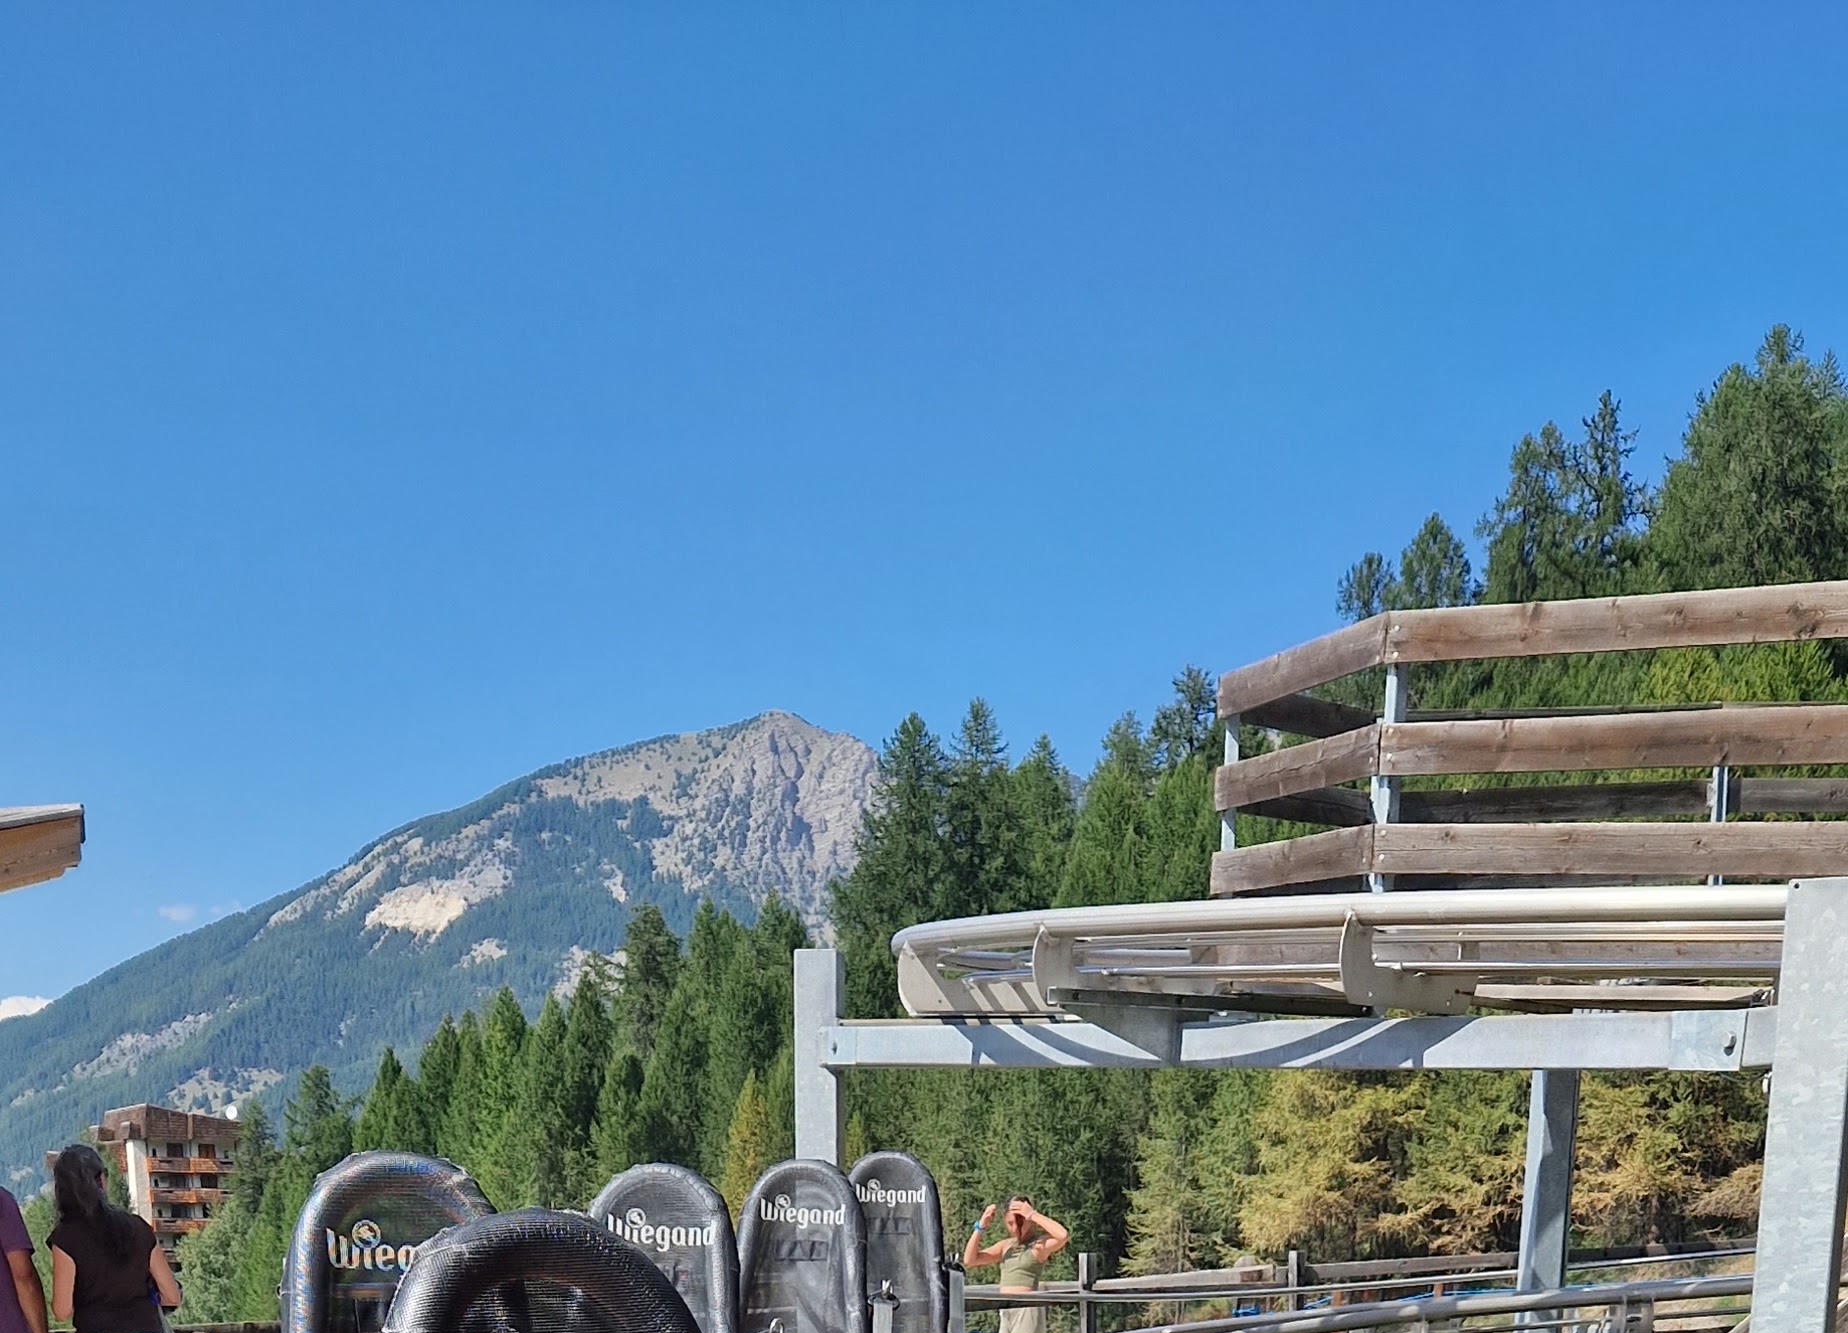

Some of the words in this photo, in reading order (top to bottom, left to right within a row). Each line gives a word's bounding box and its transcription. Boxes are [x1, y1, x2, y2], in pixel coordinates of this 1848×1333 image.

[760, 1193, 847, 1229] Wiegand
[855, 1178, 927, 1208] Wiegand
[326, 1219, 415, 1272] Wieg
